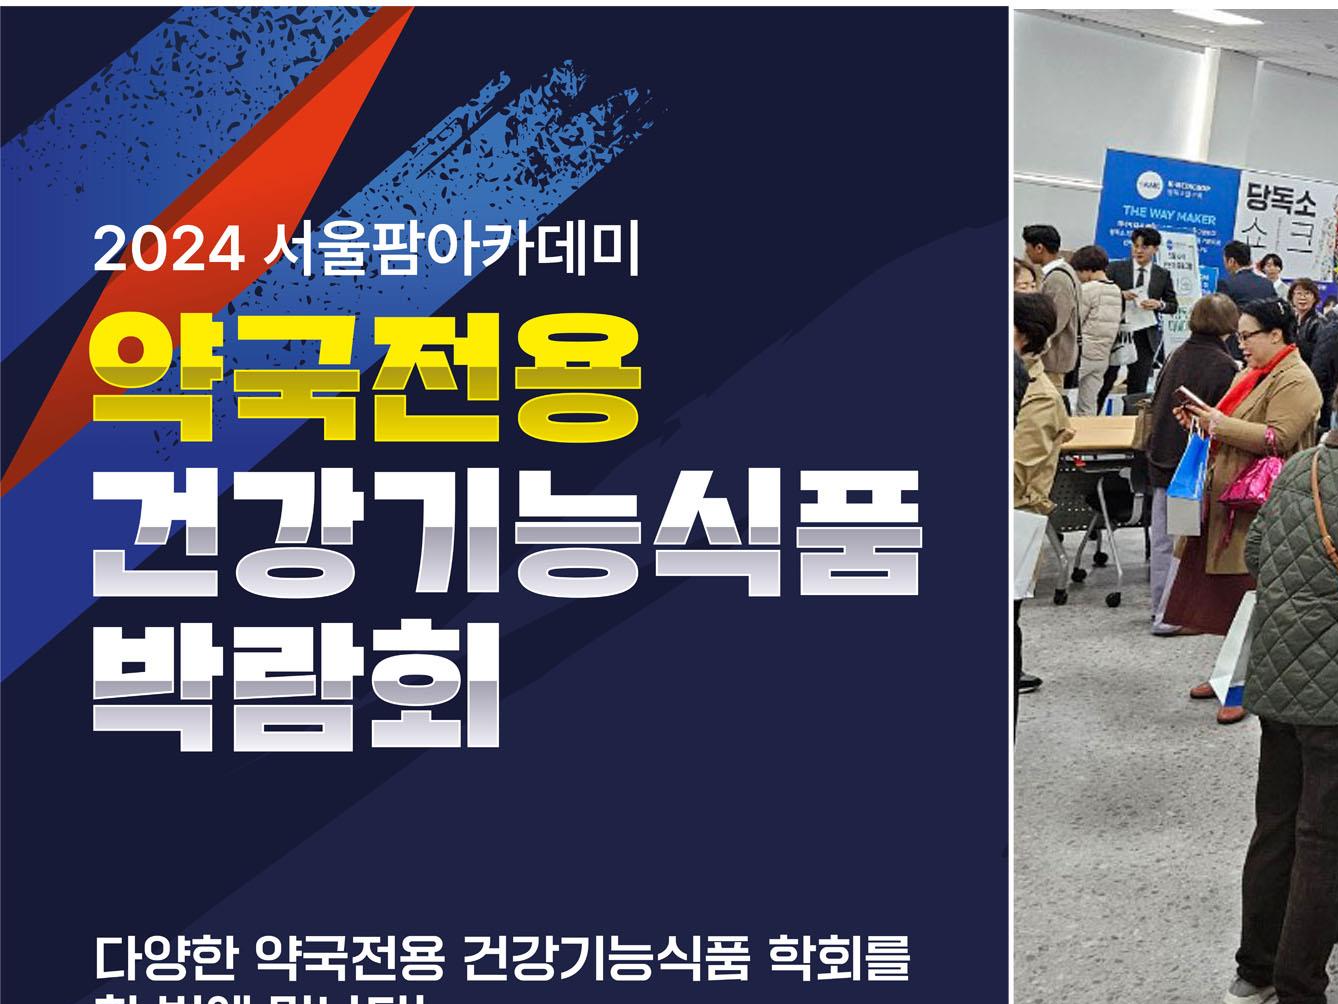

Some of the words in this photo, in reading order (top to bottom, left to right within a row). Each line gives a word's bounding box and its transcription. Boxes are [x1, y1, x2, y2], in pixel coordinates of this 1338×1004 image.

[1123, 204, 1147, 219] THE
[1149, 207, 1176, 222] WAY
[1176, 210, 1216, 226] MAKER
[1247, 182, 1316, 217] 당독소
[94, 224, 245, 272] 2024
[263, 219, 638, 276] 서울팜아카데미
[88, 311, 642, 442] 약국전용
[92, 468, 924, 598] 건강기능식품
[92, 619, 500, 752] 박람회
[95, 935, 239, 983] 다양한
[255, 935, 446, 983] 약국전용
[462, 935, 751, 983] 건강기능식품
[769, 935, 912, 983] 학회를
